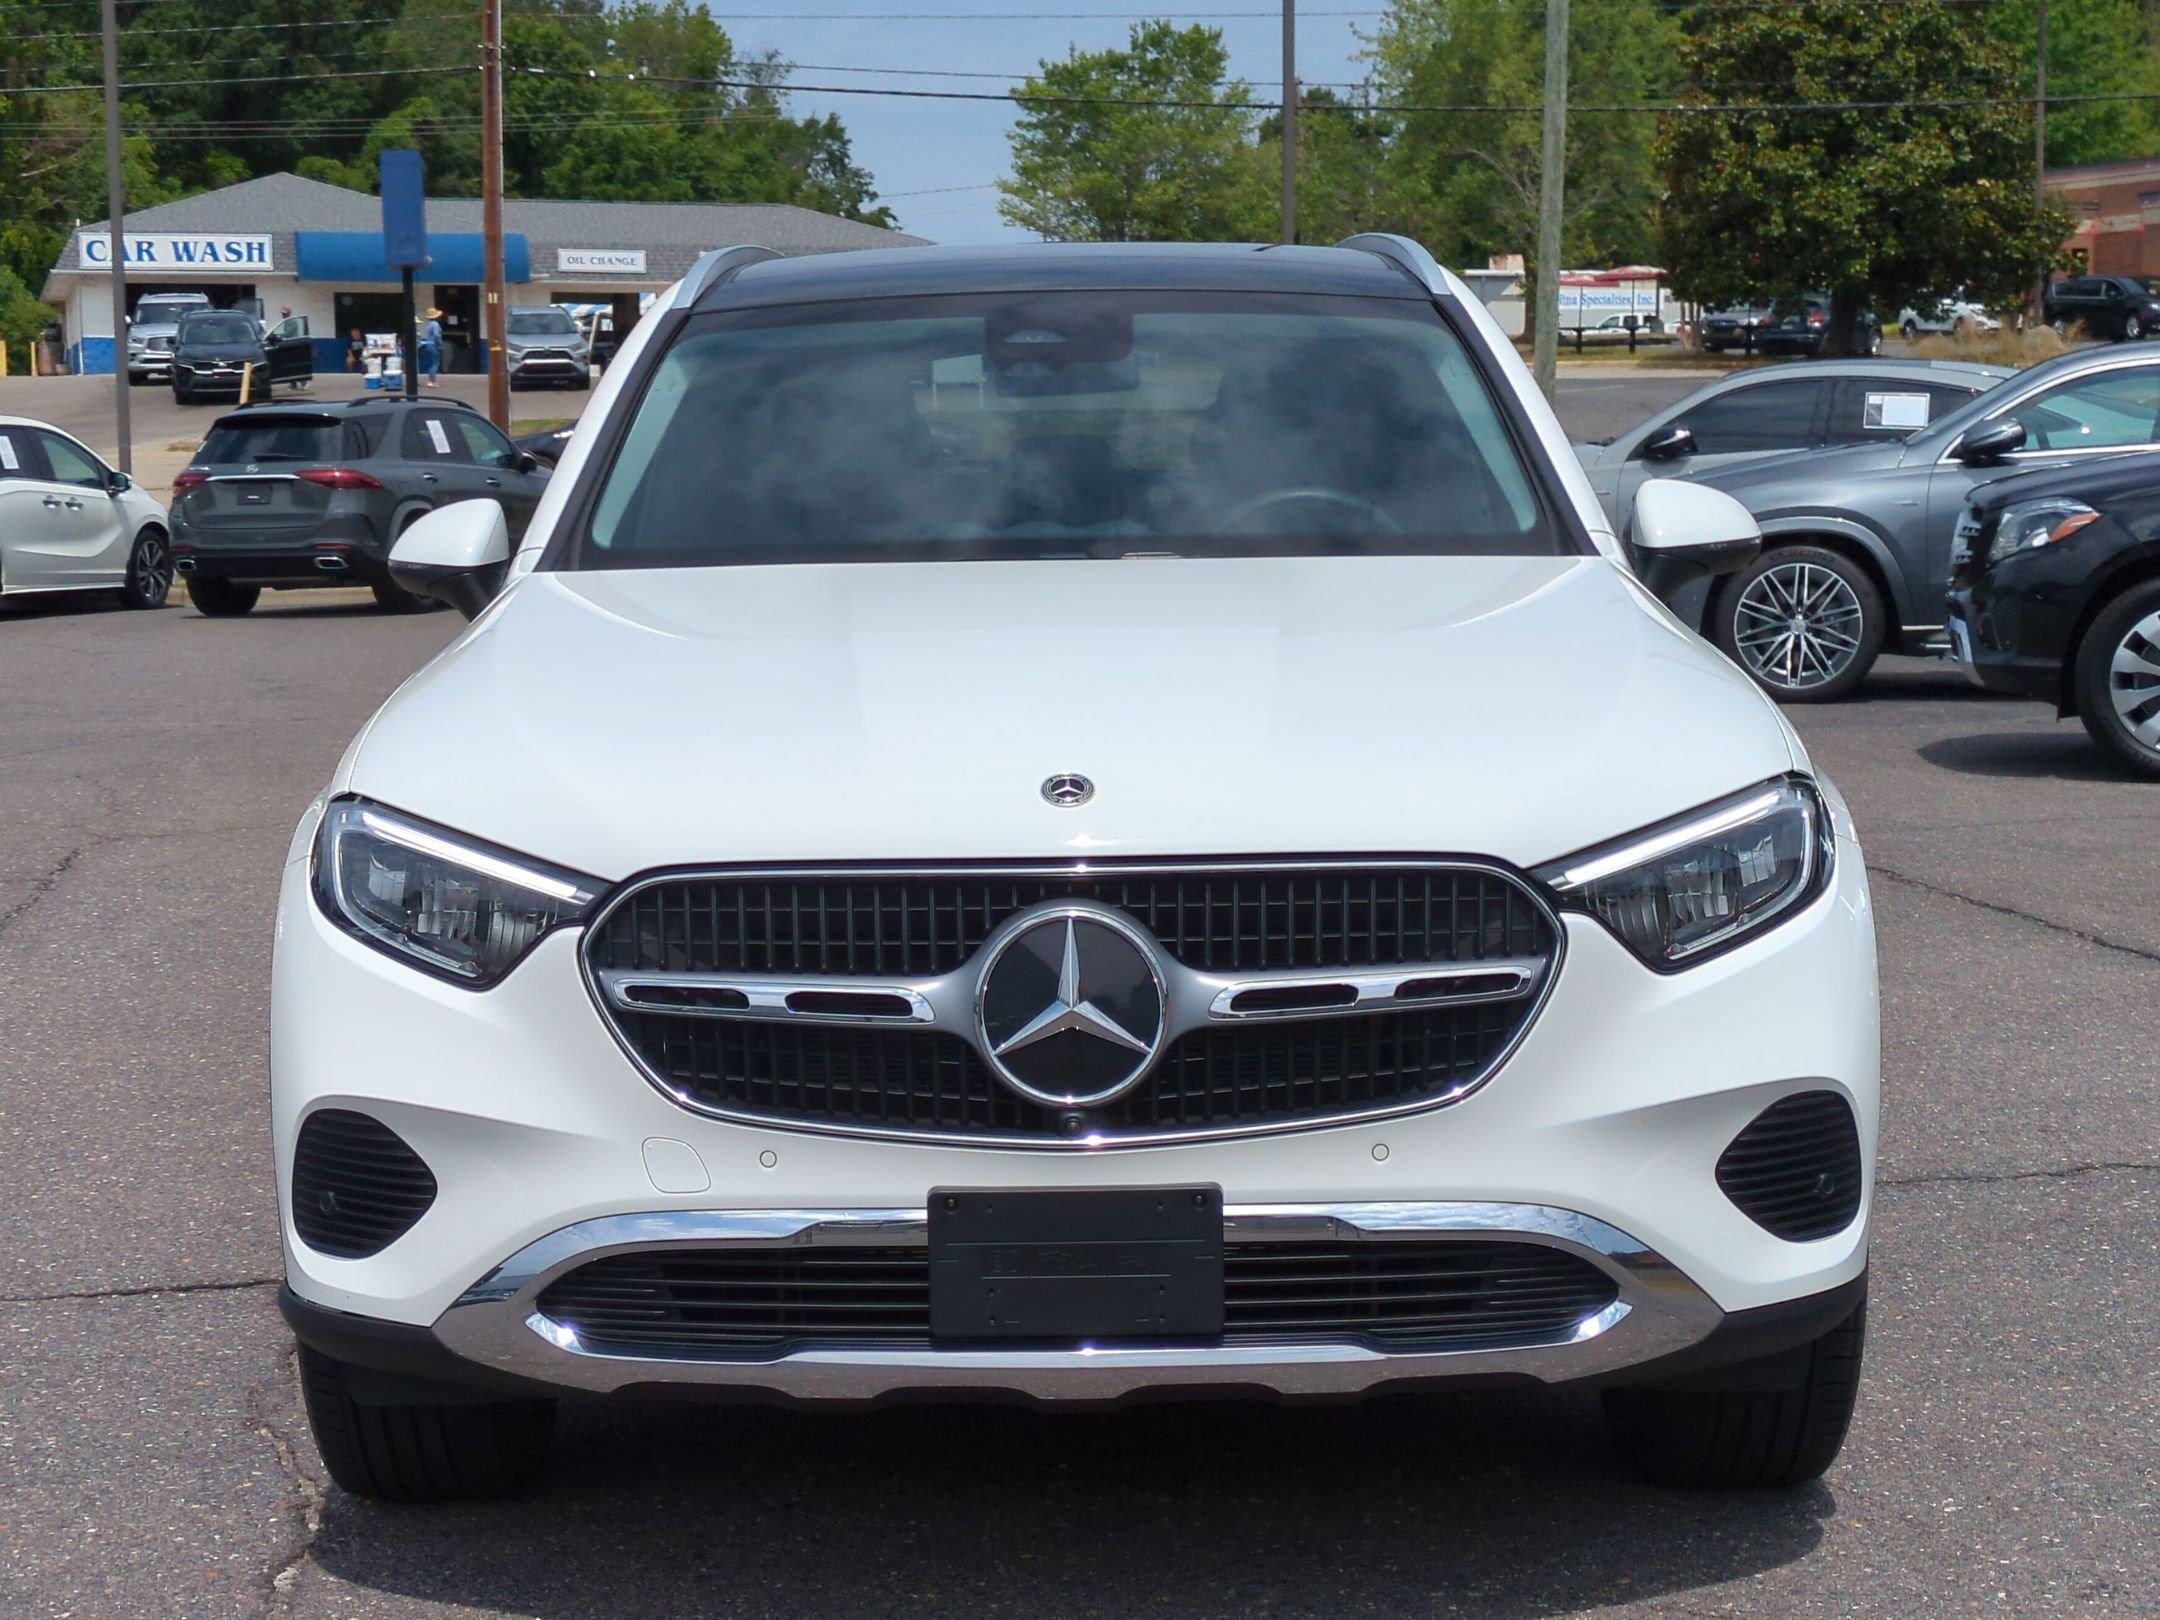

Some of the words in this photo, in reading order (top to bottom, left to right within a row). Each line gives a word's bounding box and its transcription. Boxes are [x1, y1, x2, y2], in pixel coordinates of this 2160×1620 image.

[171, 241, 266, 262] WASH
[567, 256, 586, 265] OIL
[590, 256, 637, 266] CHANGE
[1558, 293, 1578, 305] lina
